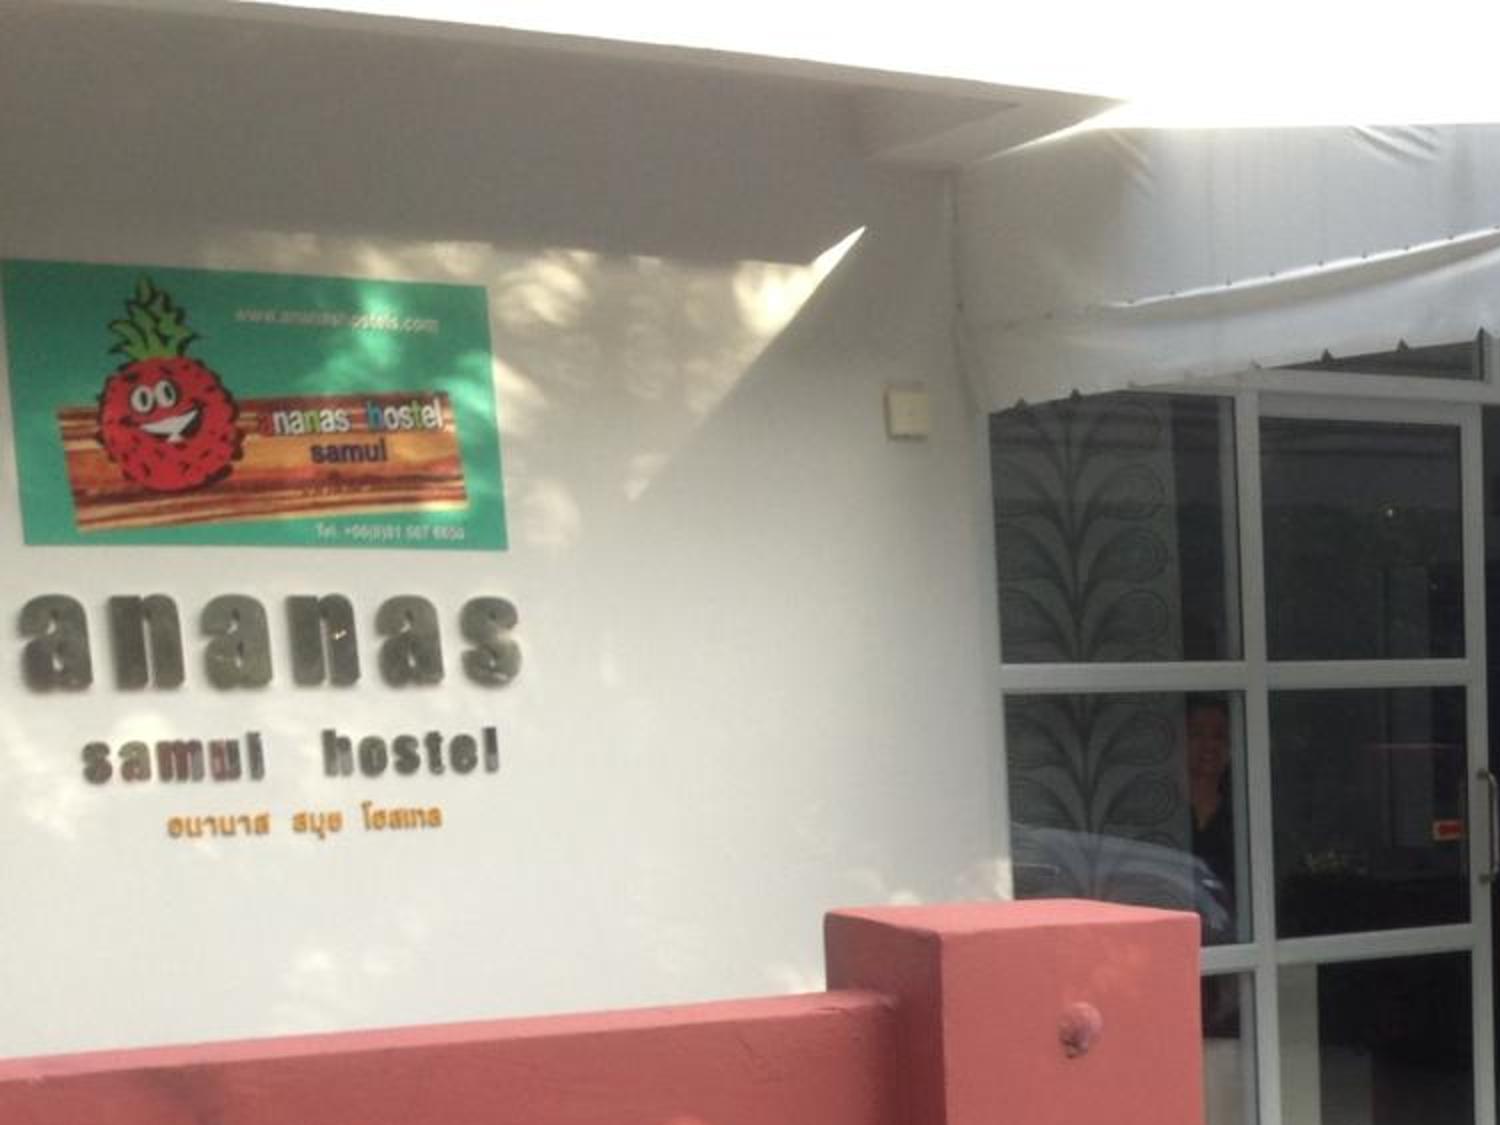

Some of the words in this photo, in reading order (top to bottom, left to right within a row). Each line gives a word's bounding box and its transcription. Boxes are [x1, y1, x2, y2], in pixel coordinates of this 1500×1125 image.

[366, 397, 443, 432] hostel
[18, 592, 522, 692] ananas
[81, 731, 266, 785] samui
[321, 726, 500, 778] hostel
